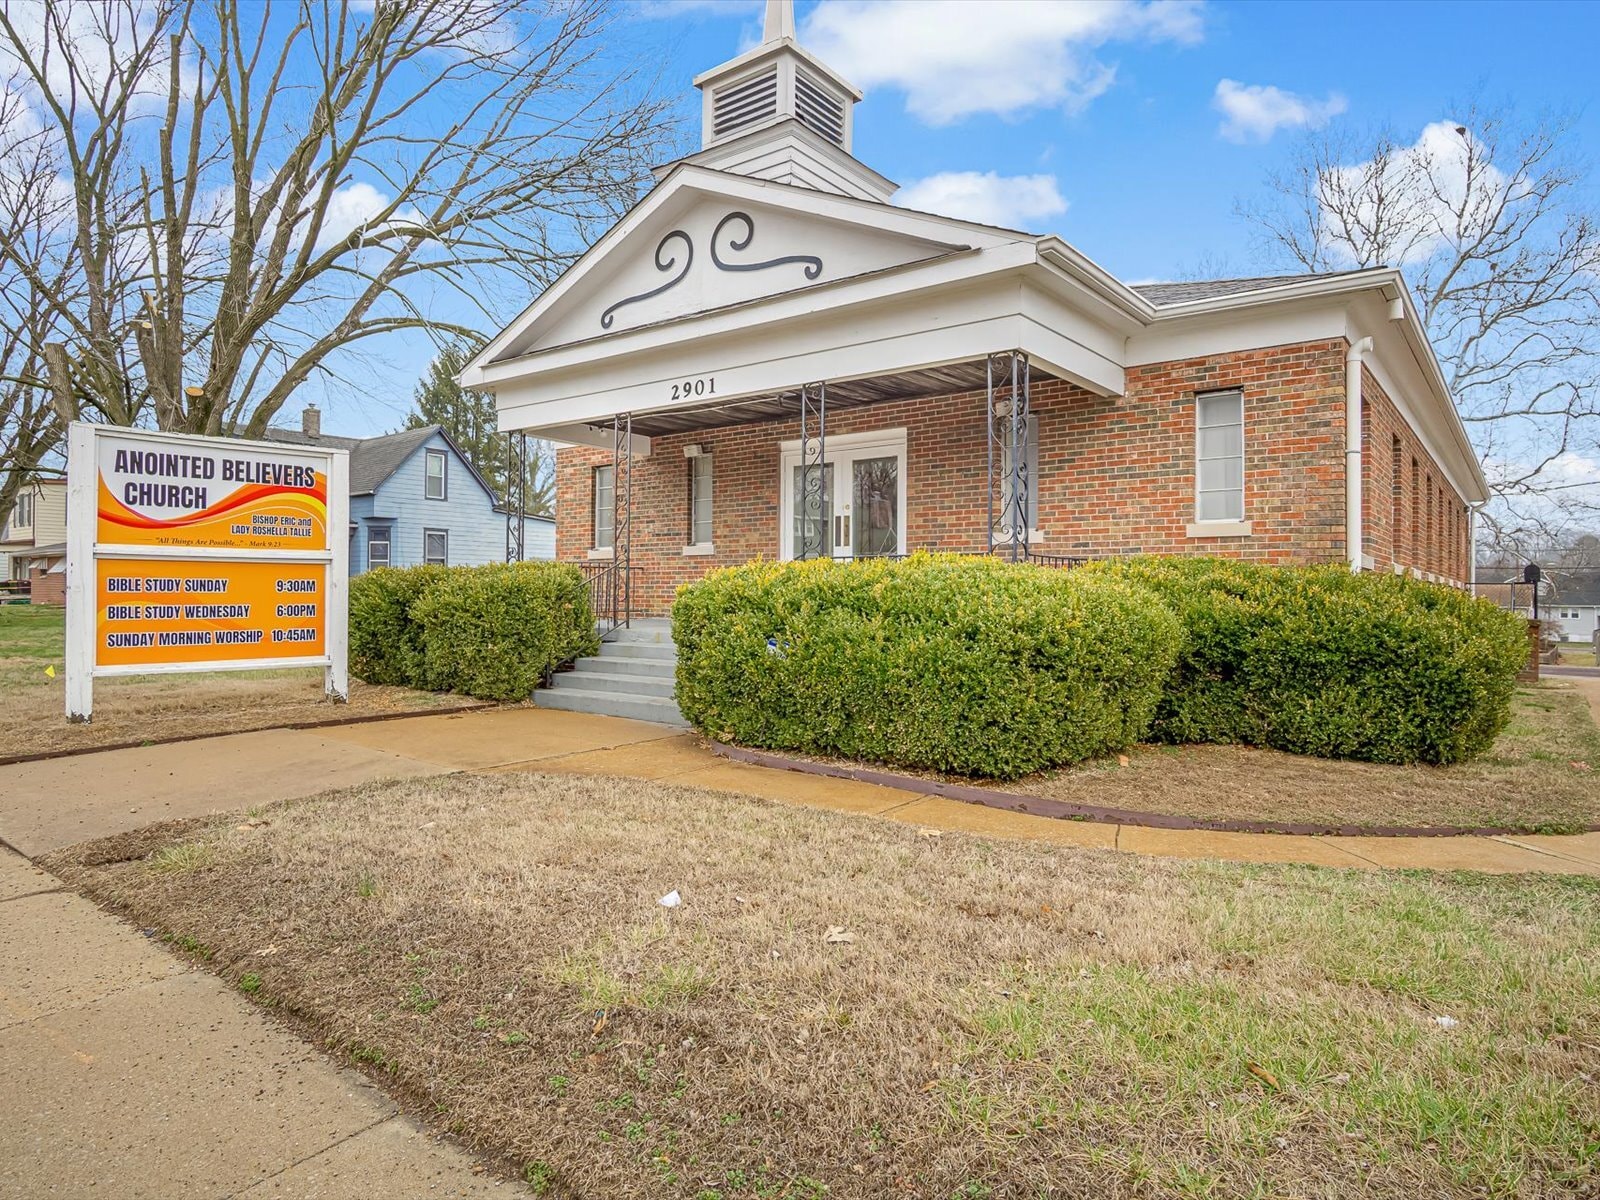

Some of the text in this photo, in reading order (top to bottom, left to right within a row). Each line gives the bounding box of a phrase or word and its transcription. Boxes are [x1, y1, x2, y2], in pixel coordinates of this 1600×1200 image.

[671, 377, 716, 401] 2901
[114, 449, 315, 488] ANOINTED BELIEVERS
[124, 482, 207, 510] CHURCH
[252, 515, 312, 527] BISHOP ERIC and
[231, 525, 312, 537] LADY ROSHELLA TALLIE
[171, 537, 194, 546] Things
[108, 578, 316, 592] BIBLE STUDY SUNDAY 9:30AM
[108, 605, 316, 619] BIBLE STUDY WEDNESDAY 6:00PM
[107, 629, 316, 647] SUNDAY MORNING WORSHIP 10:45AM
